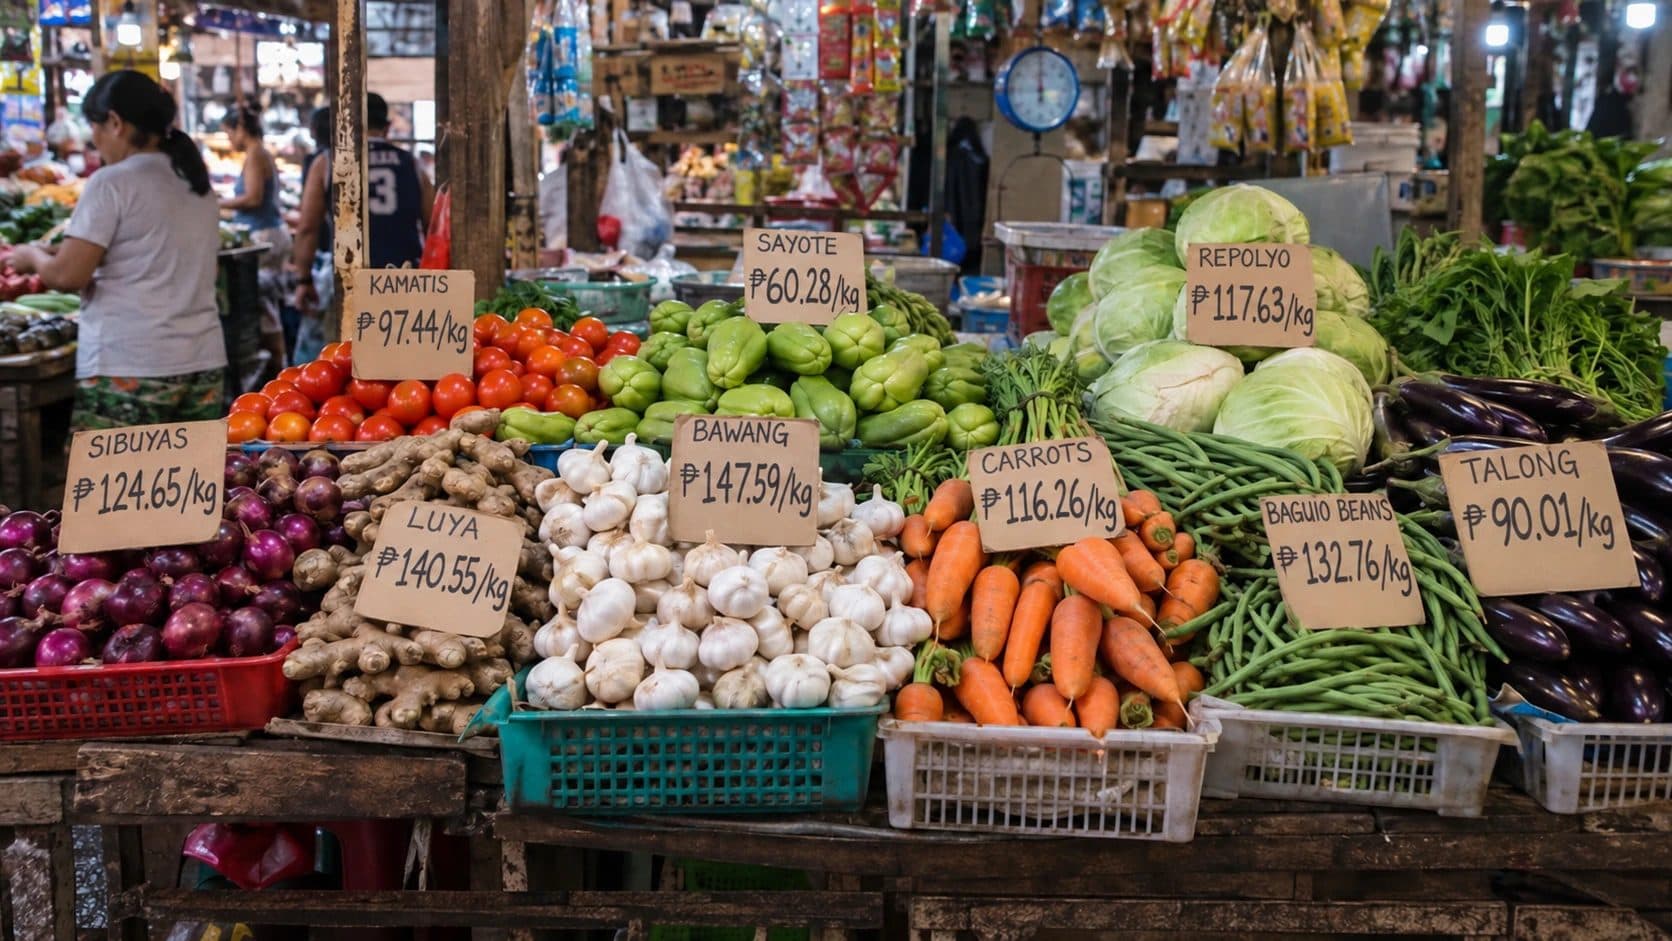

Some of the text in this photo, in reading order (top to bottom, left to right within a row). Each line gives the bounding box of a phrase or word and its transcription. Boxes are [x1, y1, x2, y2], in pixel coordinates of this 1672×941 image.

[757, 234, 837, 255] SAYOTE
[1199, 247, 1291, 269] REPOLYO
[369, 274, 449, 296] KAMATIS
[749, 267, 860, 313] ₱60.28/kg
[1191, 284, 1314, 337] ₱117.63/kg
[356, 309, 468, 355] ₱97.44/kg
[88, 427, 188, 459] SIBUYAS
[693, 419, 789, 447] BAWANG
[982, 441, 1092, 474] CARROTS
[1460, 449, 1580, 484] TALONG
[72, 466, 217, 516] ₱124.65/kg
[679, 461, 812, 518] ₱147.59/kg
[981, 478, 1117, 533] ₱116.26/kg
[407, 506, 479, 540] LUYA
[1264, 498, 1393, 525] BAGUIO BEANS
[1462, 491, 1615, 551] ₱90.01/kg
[375, 546, 509, 612] ₱140.55/kg
[1276, 539, 1413, 597] ₱132.76/kg
